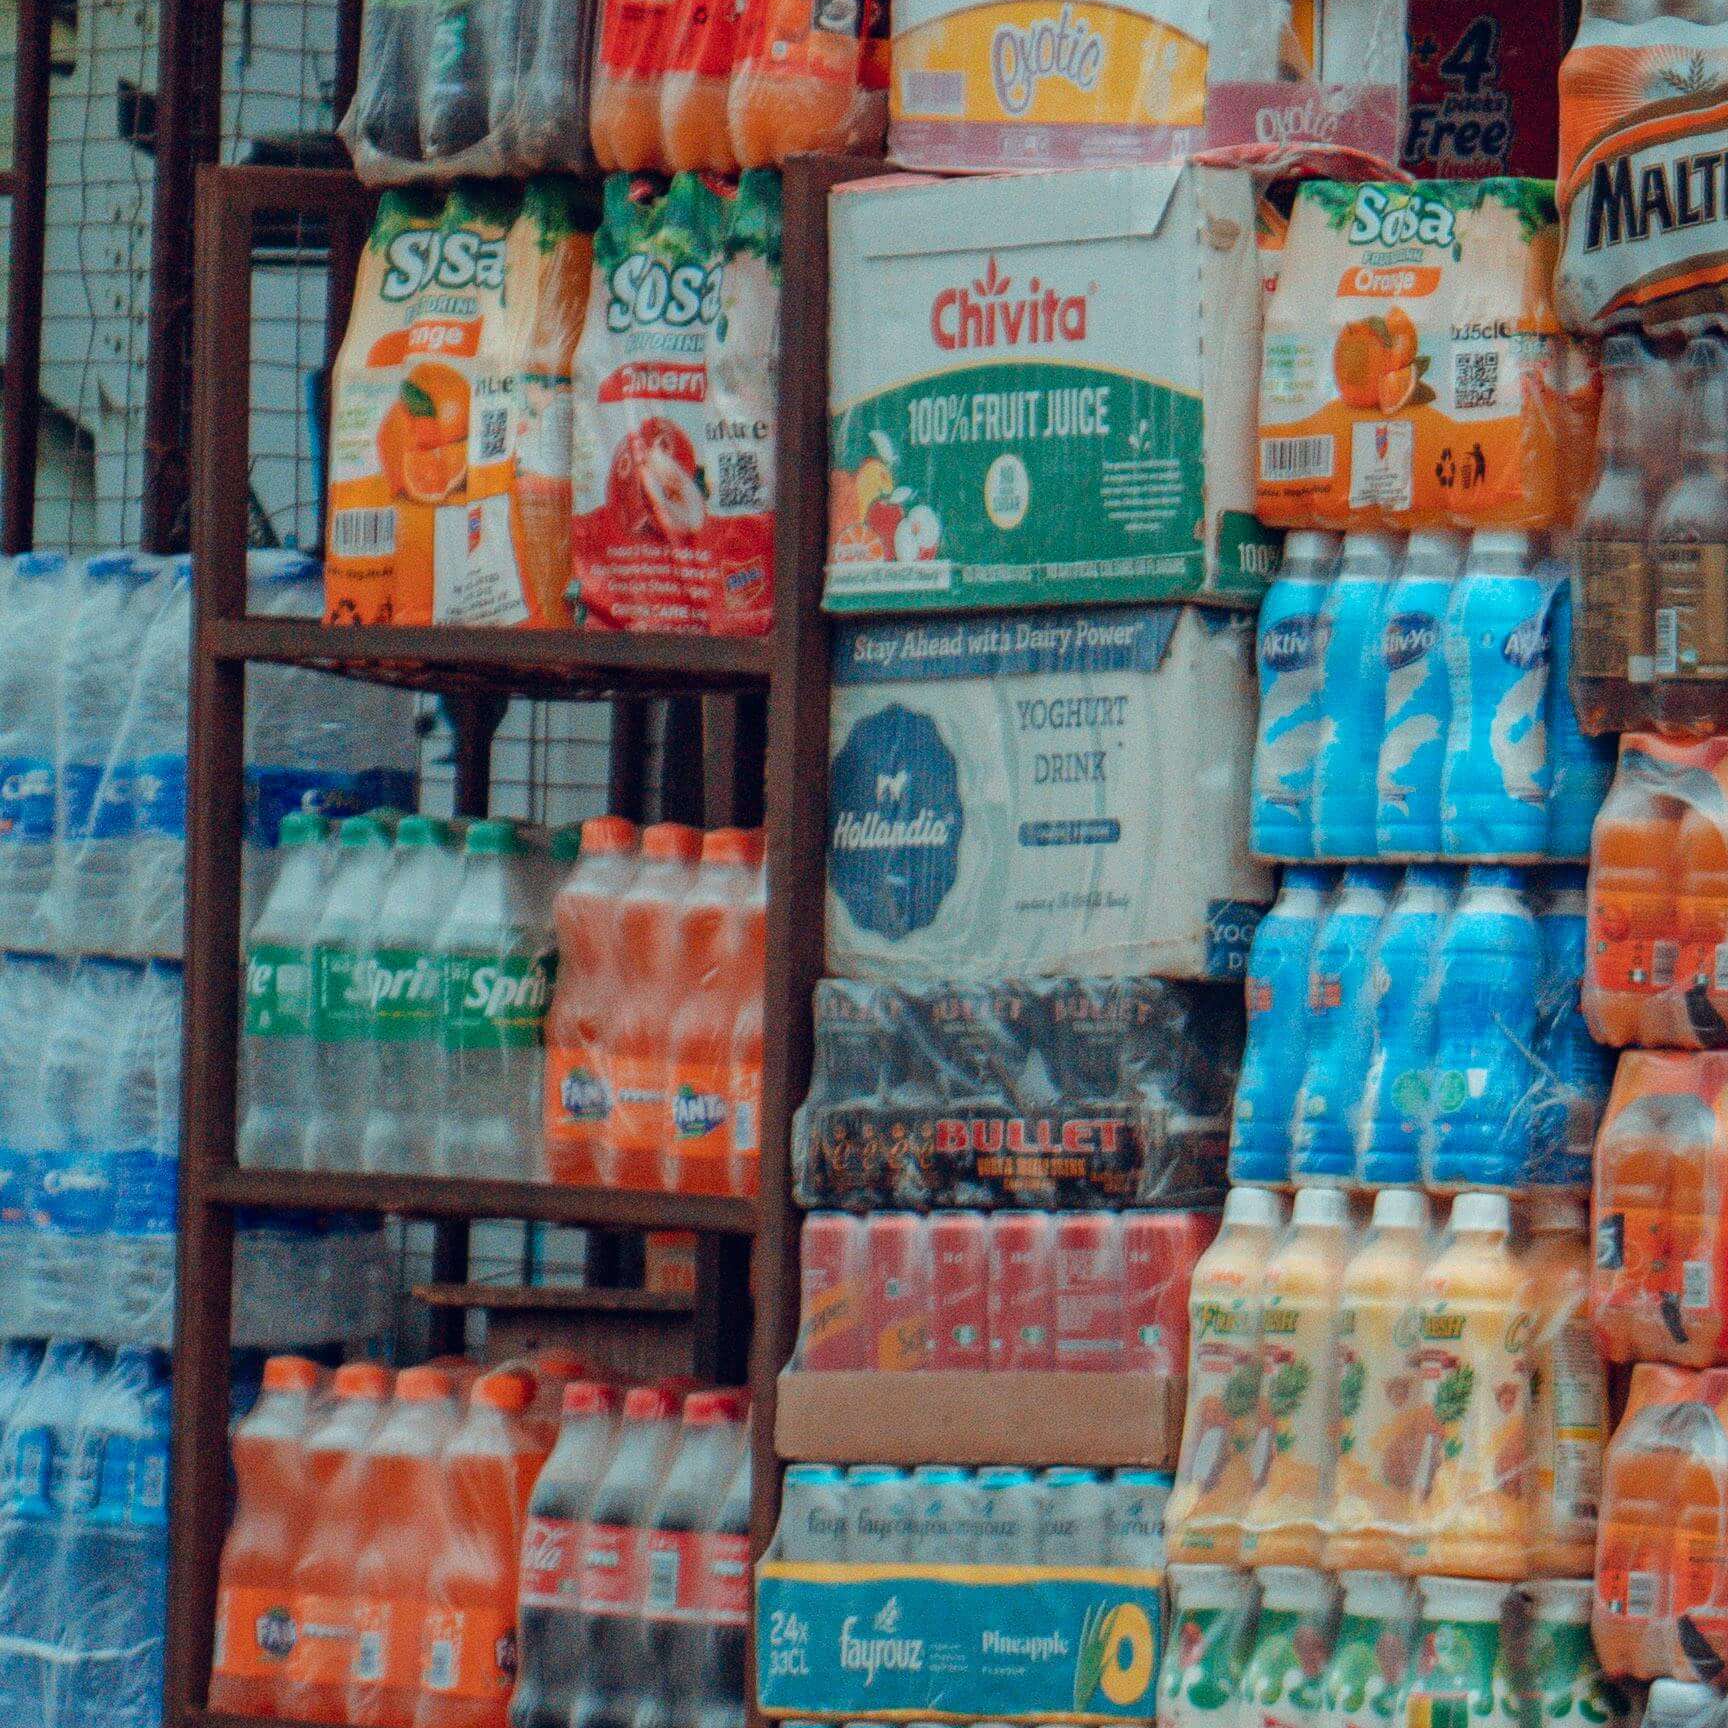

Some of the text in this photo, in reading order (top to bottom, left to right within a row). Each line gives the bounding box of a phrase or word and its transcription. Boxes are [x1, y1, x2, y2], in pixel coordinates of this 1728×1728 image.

[1404, 108, 1508, 158] Free
[931, 264, 1088, 350] Chivita
[907, 386, 1111, 447] 100% FRUIT JUICE
[853, 631, 897, 664] Stay
[900, 627, 965, 659] Ahead
[967, 625, 1012, 654] with
[1015, 622, 1072, 657] Dairy
[1017, 695, 1128, 732] YOGHURT
[1033, 750, 1107, 785] DRINK
[833, 811, 948, 851] Hollandia
[936, 1118, 1126, 1153] BULLET
[841, 1615, 925, 1689] fayrouz
[982, 1630, 1070, 1657] Pineapple
